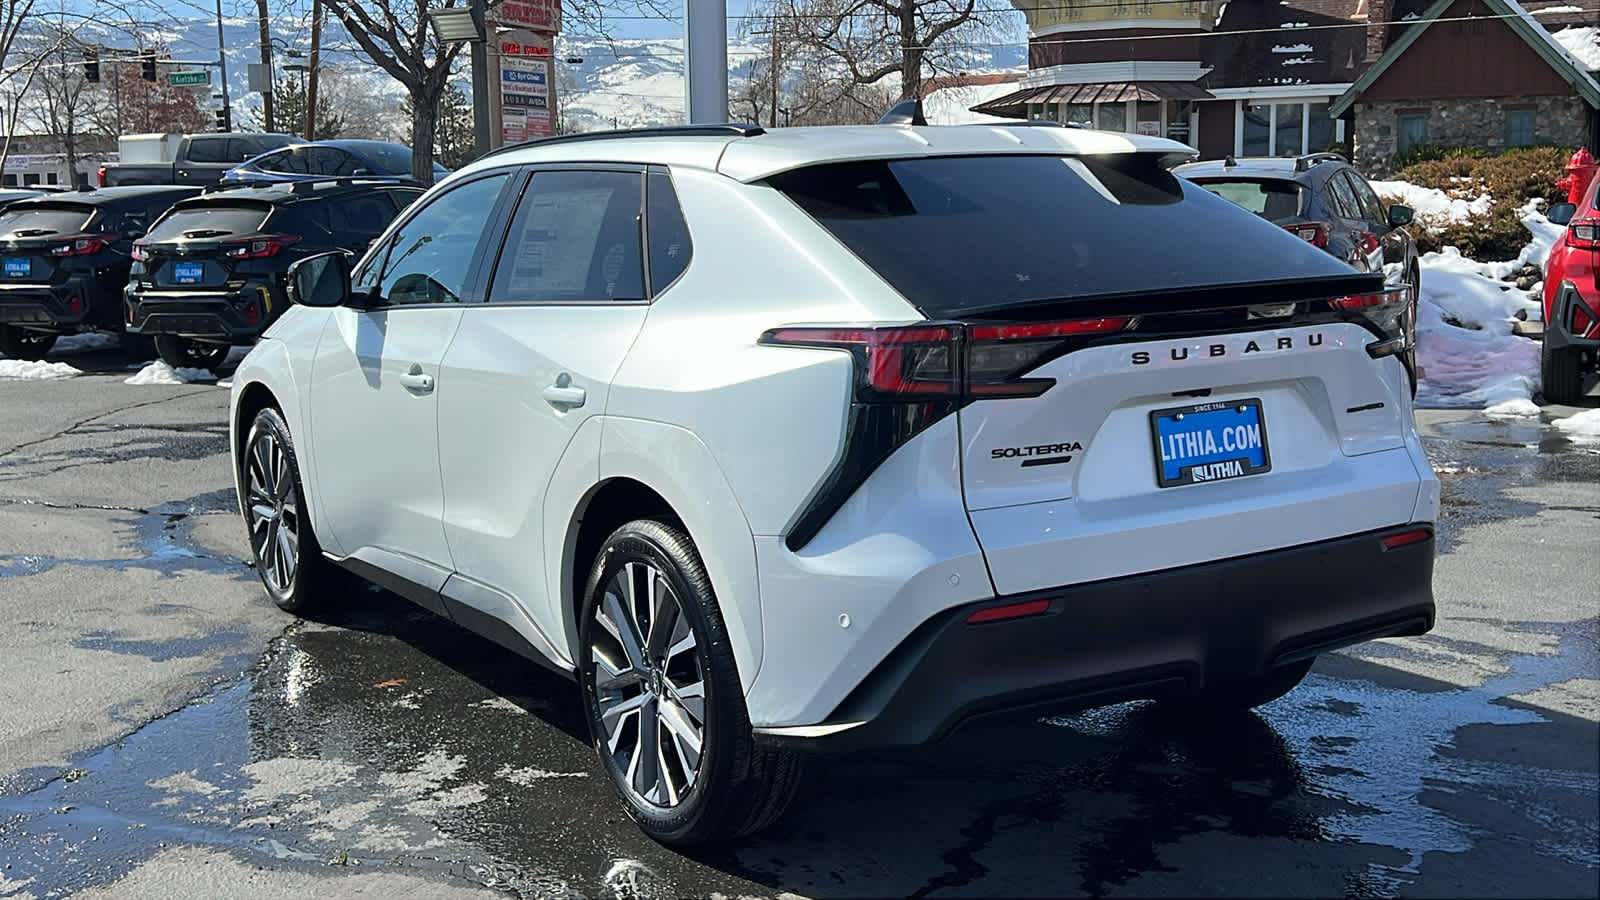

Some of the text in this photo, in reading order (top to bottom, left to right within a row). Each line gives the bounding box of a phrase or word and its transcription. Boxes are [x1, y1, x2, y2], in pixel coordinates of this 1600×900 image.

[1131, 333, 1322, 365] SUBARU
[1194, 405, 1212, 413] SINCE
[991, 442, 1083, 459] SOLTERRA
[1160, 423, 1262, 461] LITHIA.COM
[1204, 460, 1244, 480] LITHIA
